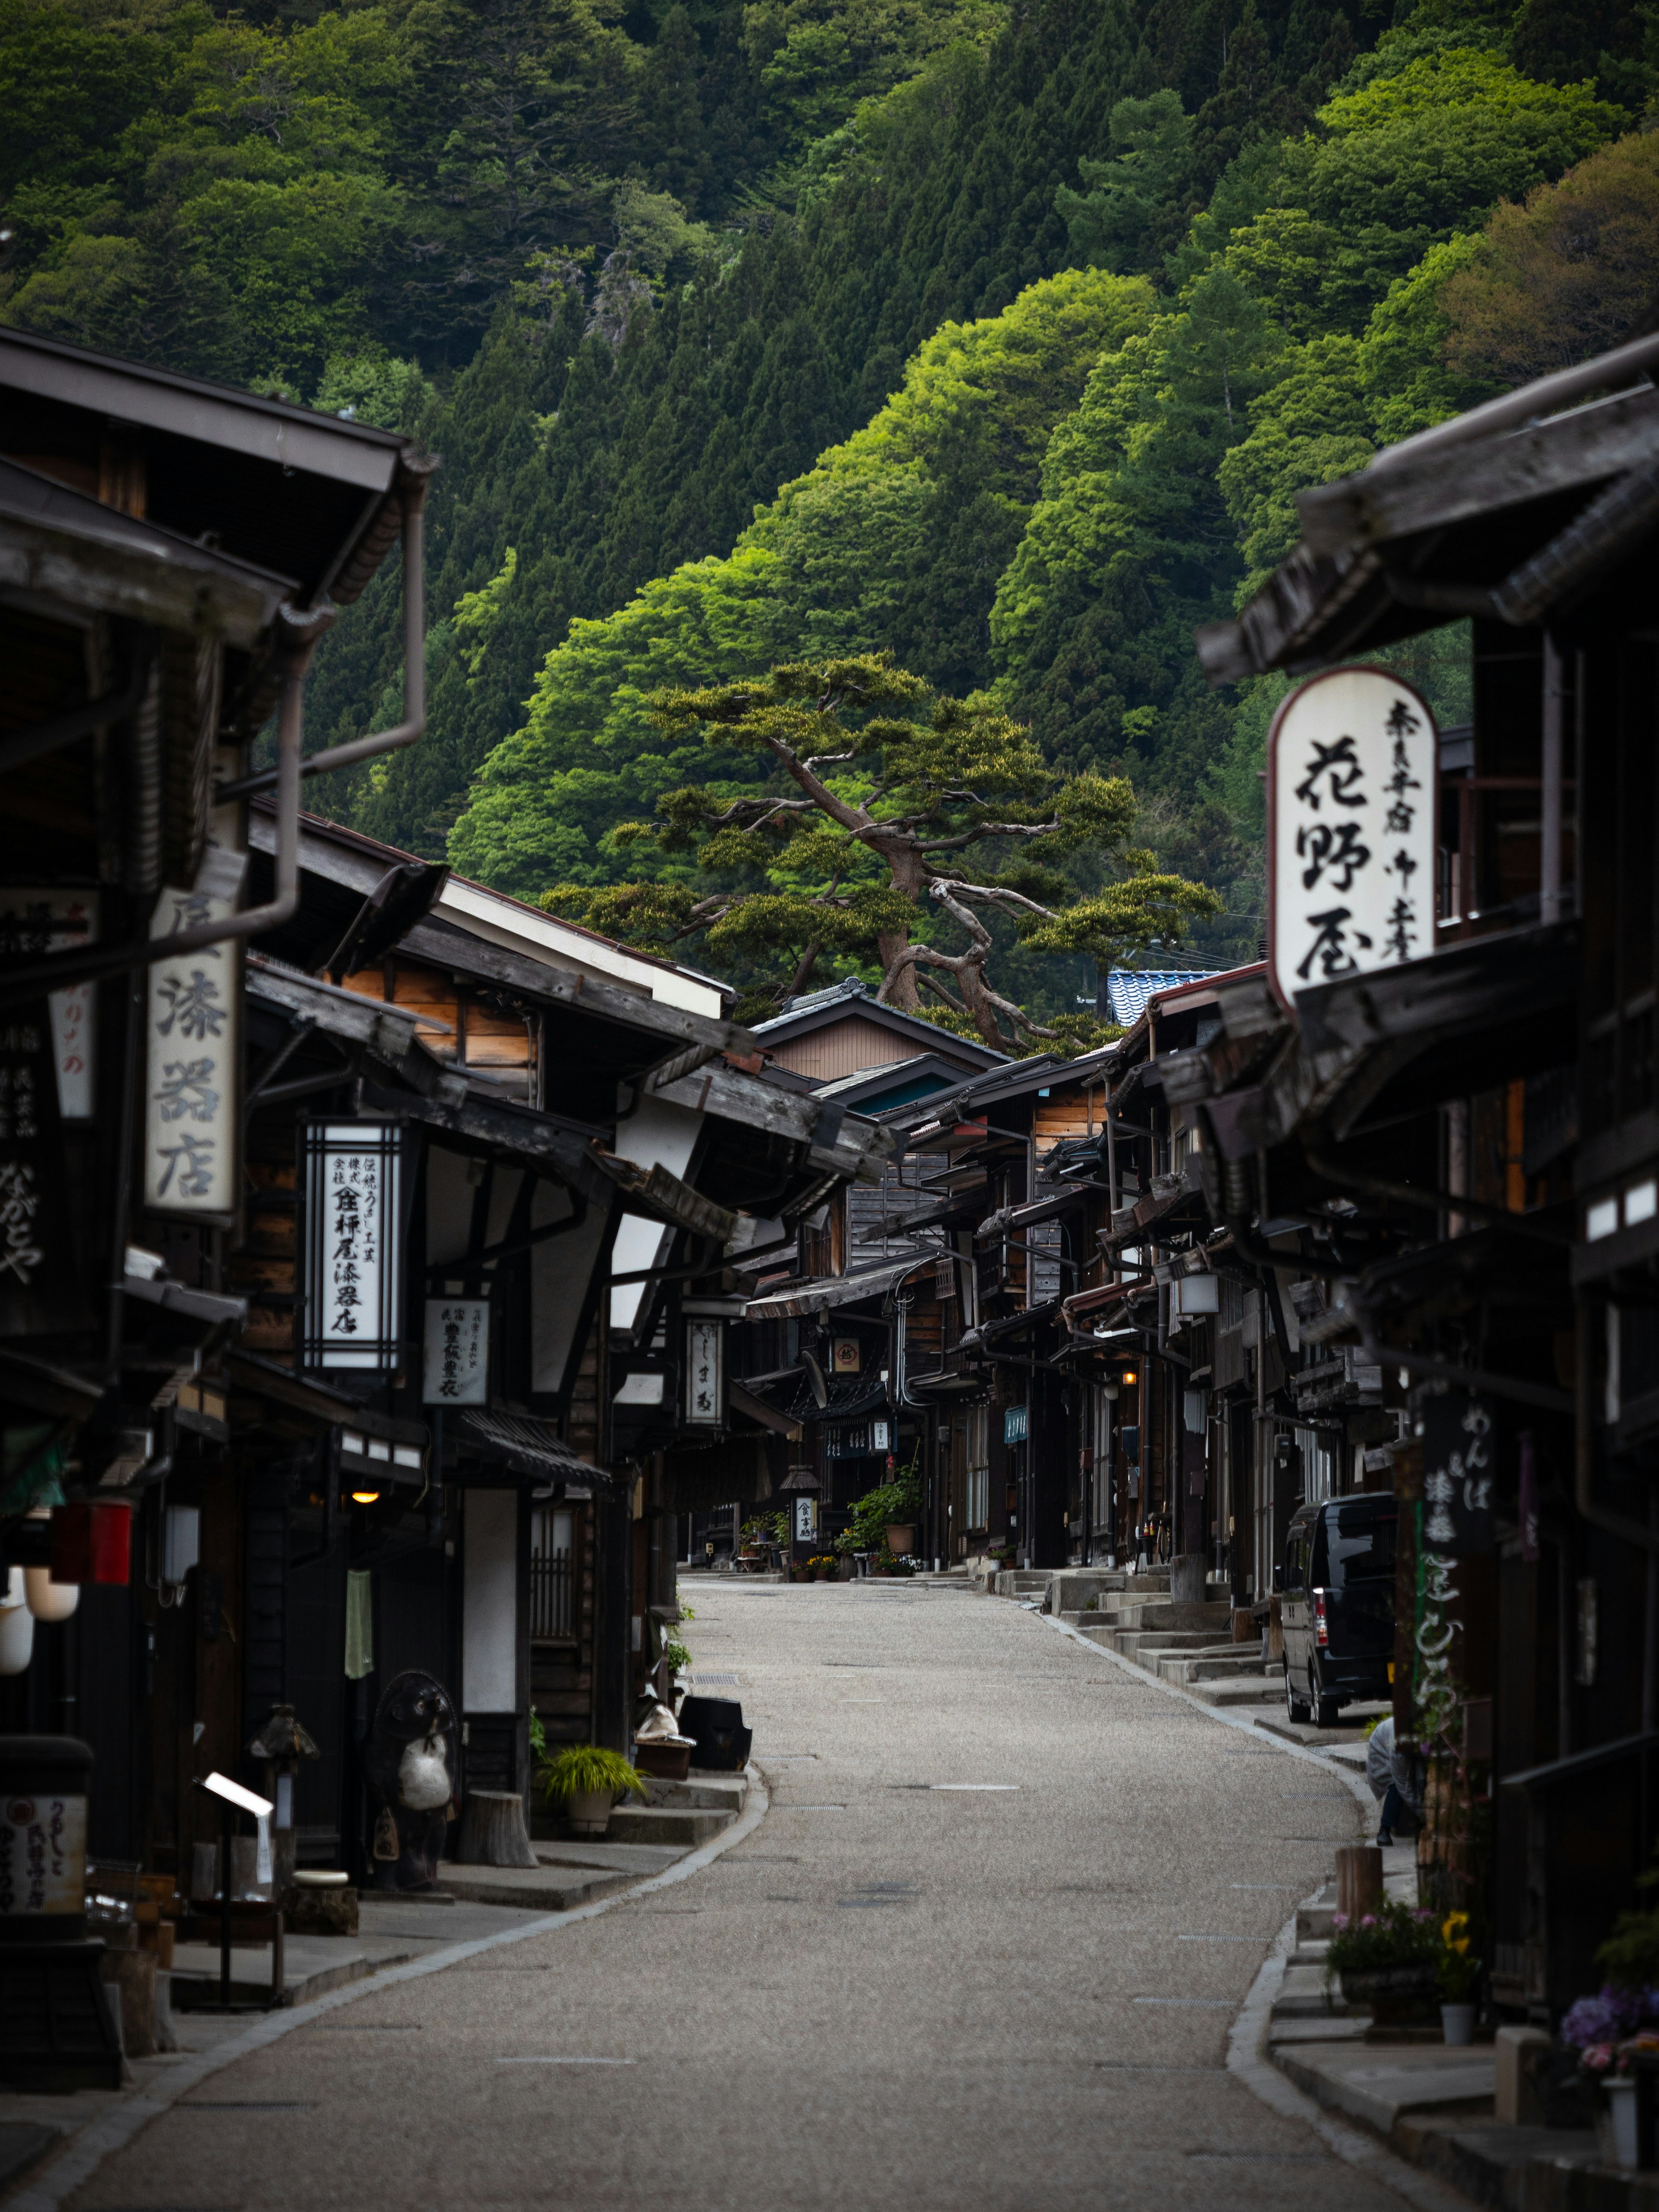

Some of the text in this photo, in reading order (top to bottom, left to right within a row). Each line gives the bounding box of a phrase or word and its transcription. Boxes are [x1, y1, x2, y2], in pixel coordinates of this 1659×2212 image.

[1294, 736, 1373, 981] 花野屋
[798, 1502, 810, 1537] 食事処
